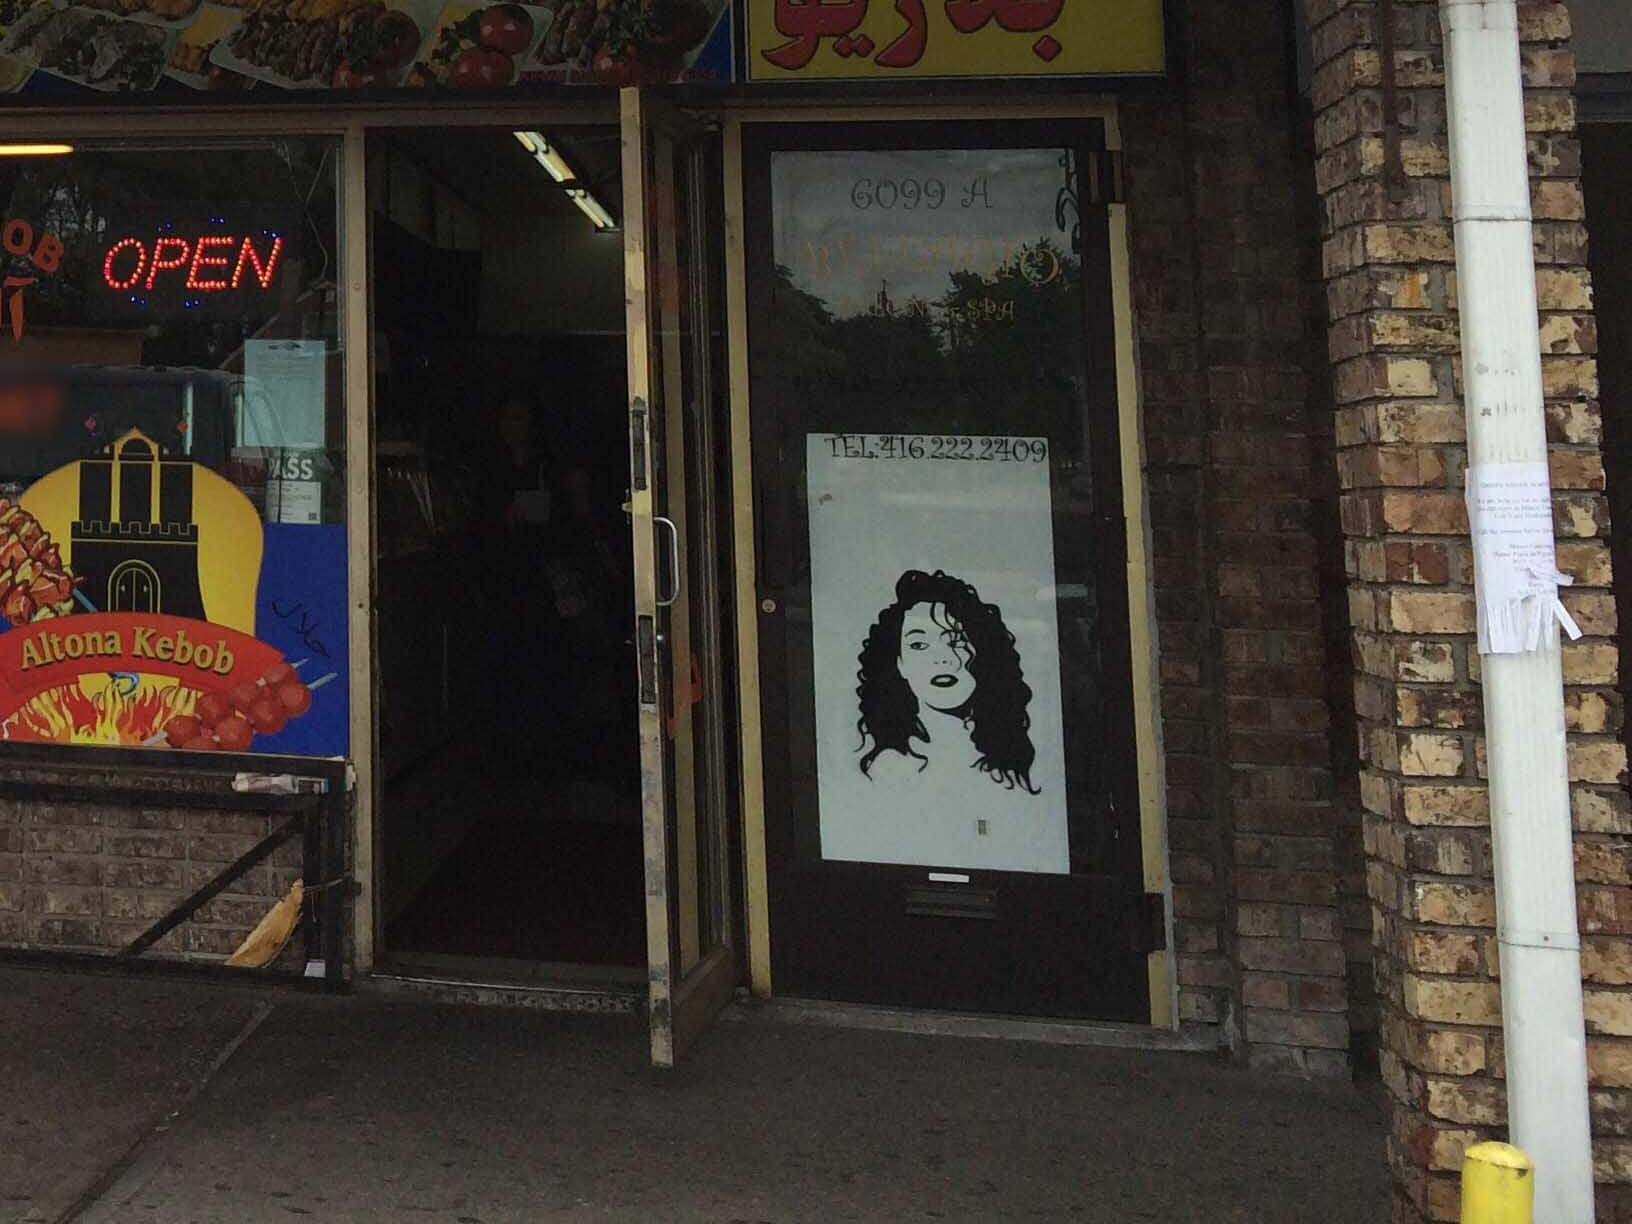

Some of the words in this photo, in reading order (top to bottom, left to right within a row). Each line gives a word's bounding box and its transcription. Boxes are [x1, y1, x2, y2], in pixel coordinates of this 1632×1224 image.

[851, 177, 946, 210] 6099
[961, 176, 993, 209] A
[102, 234, 285, 291] OPEN
[20, 630, 123, 670] Altona
[132, 626, 236, 675] Kebob
